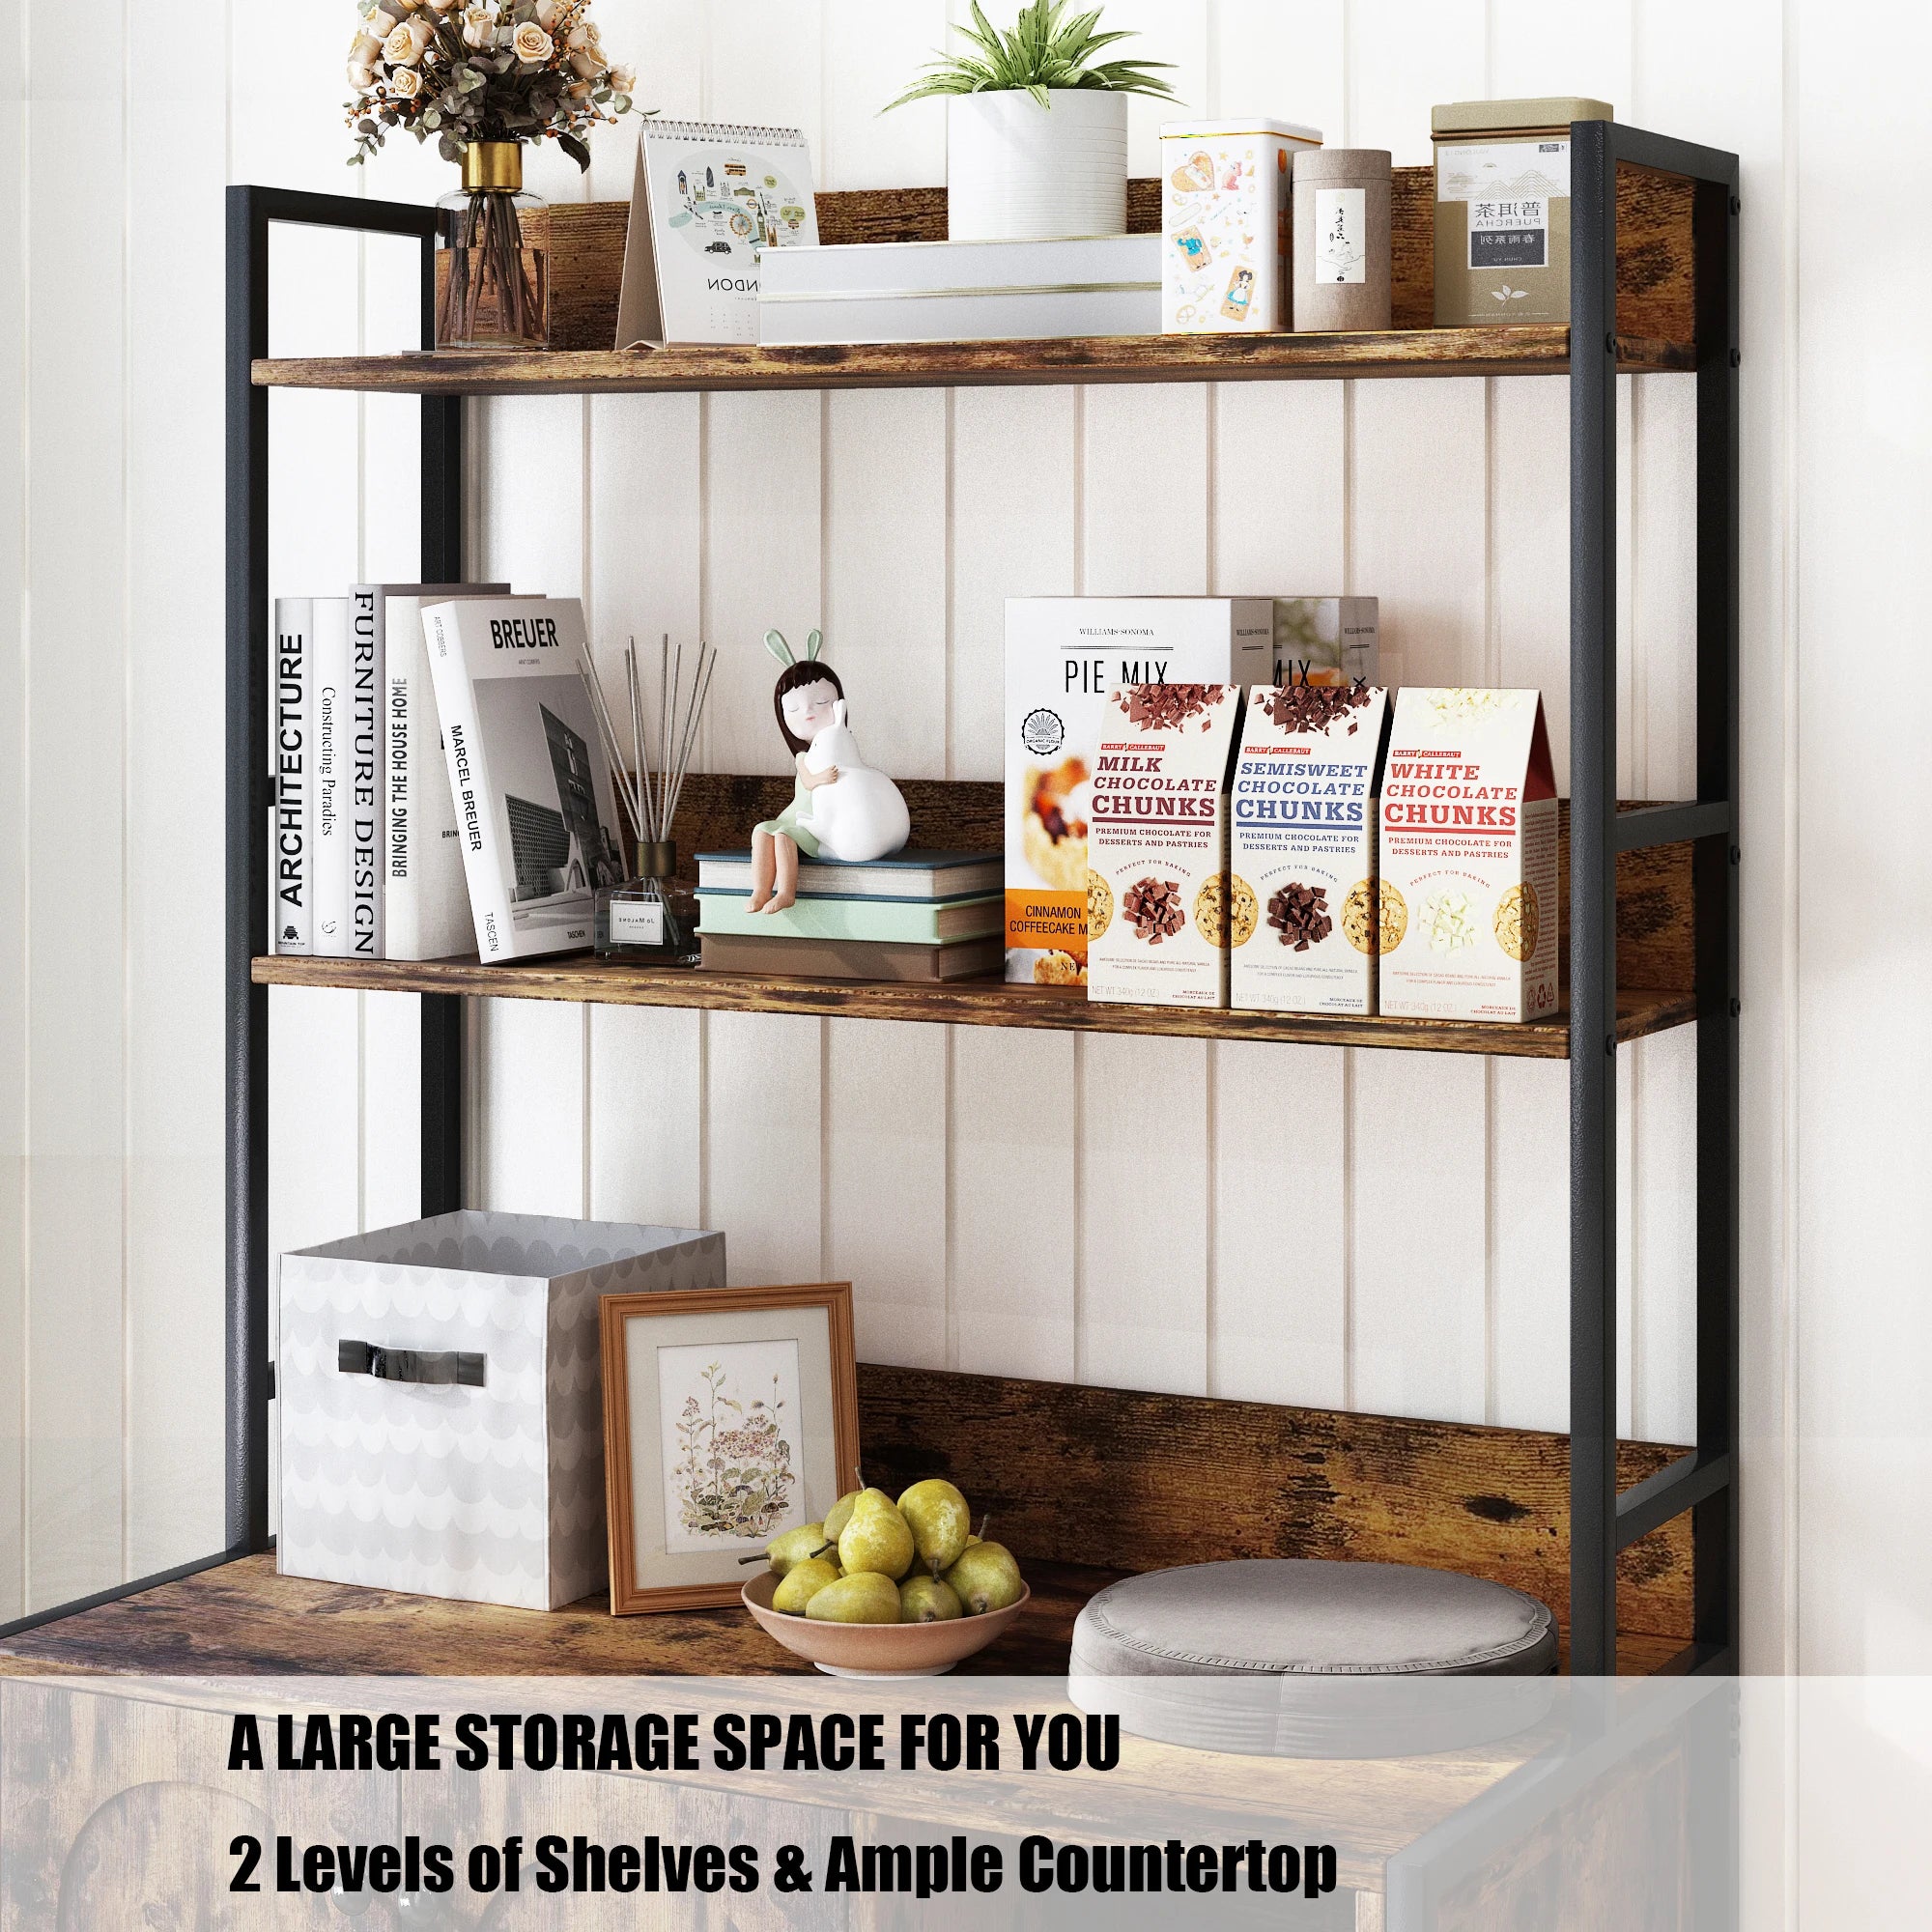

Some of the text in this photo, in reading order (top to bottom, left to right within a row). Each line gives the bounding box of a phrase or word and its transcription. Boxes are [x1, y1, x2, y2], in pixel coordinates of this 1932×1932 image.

[490, 618, 559, 649] BREUER
[1065, 660, 1168, 694] PIE MIX
[320, 687, 336, 774] Constructing
[280, 635, 302, 907] ARCHITECTURE
[1097, 756, 1163, 772] MILK
[1240, 762, 1368, 778] SEMISWEET
[1391, 763, 1480, 780] WHITE
[355, 592, 374, 954] FURNITURE DESIGN
[391, 678, 408, 877] BRINGING THE HOUSE HOME
[451, 725, 482, 851] MARCEL BREUER
[1094, 777, 1217, 792] CHOCOLATE
[1237, 781, 1365, 796] CHOCOLATE
[1386, 784, 1518, 800] CHOCOLATE
[1092, 794, 1215, 817] CHUNKS
[1236, 799, 1363, 821] CHUNKS
[1384, 803, 1516, 826] CHUNKS
[1139, 829, 1192, 838] CHOCOLATE
[1285, 834, 1339, 842] CHOCOLATE
[1435, 838, 1491, 847] CHOCOLATE
[1116, 860, 1146, 875] PERFECT
[1165, 861, 1191, 877] BAKING
[1261, 865, 1292, 881] PERFECT
[1311, 867, 1338, 883] BAKING
[1410, 870, 1441, 886] PERFECT
[1025, 905, 1081, 919] CINNAMON
[484, 912, 499, 952] TASCEN
[567, 930, 585, 940] TASCHEN
[1009, 921, 1088, 935] COFFEECAKE M
